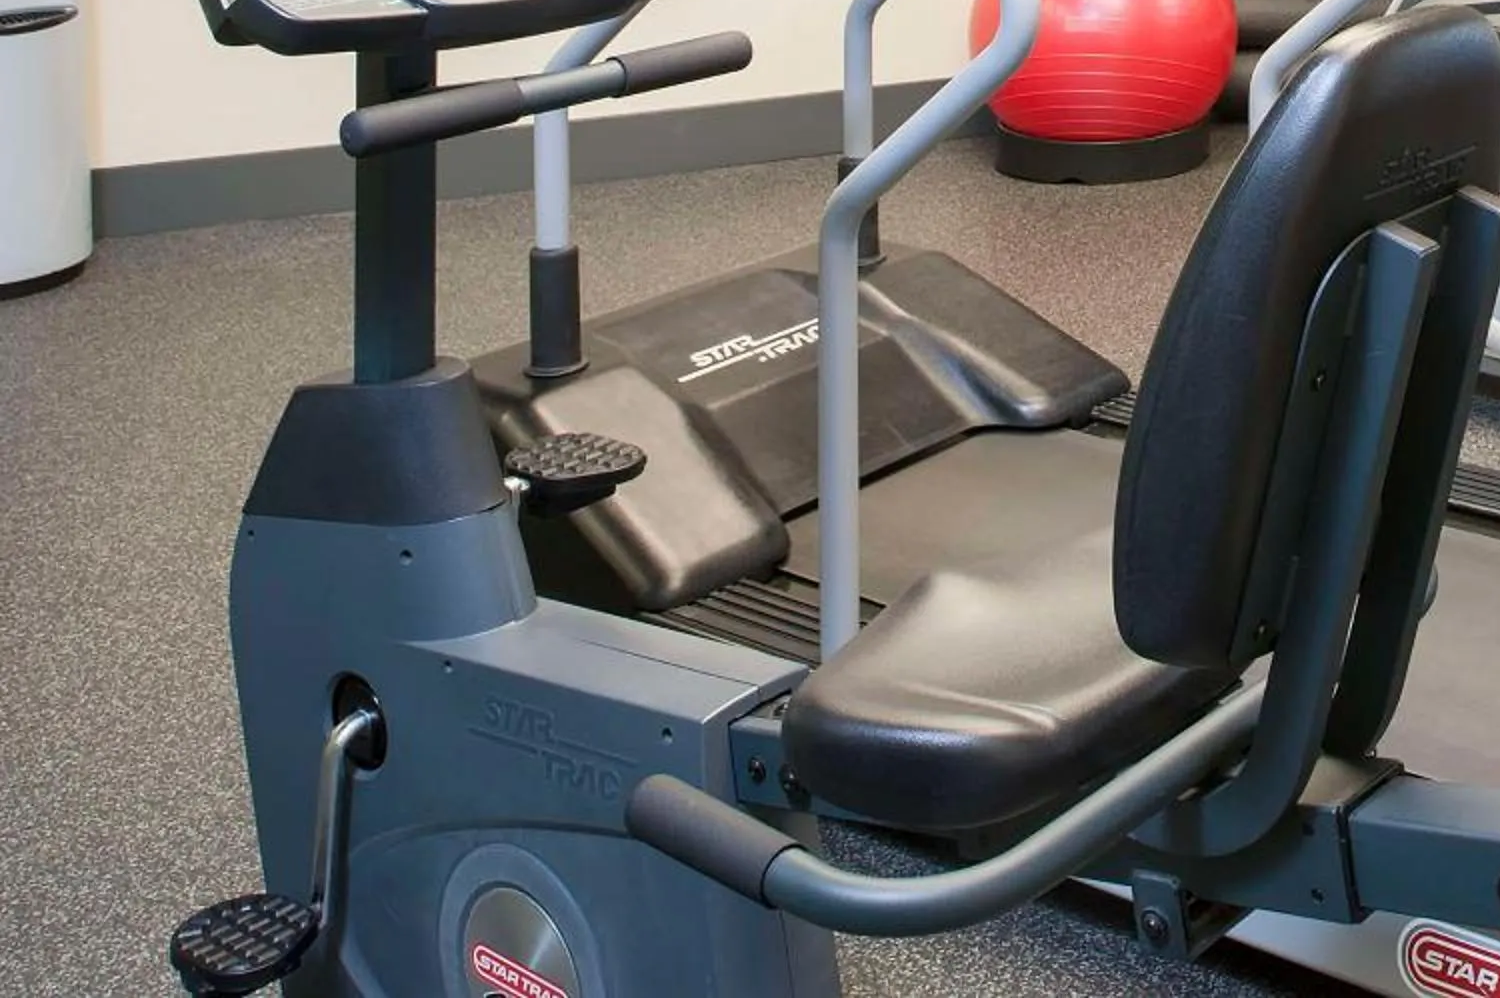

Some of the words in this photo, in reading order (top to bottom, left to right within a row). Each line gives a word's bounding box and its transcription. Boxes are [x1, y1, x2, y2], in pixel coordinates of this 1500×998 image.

[479, 955, 520, 987] STAR
[521, 977, 562, 998] TRA
[1425, 949, 1499, 992] STAR
